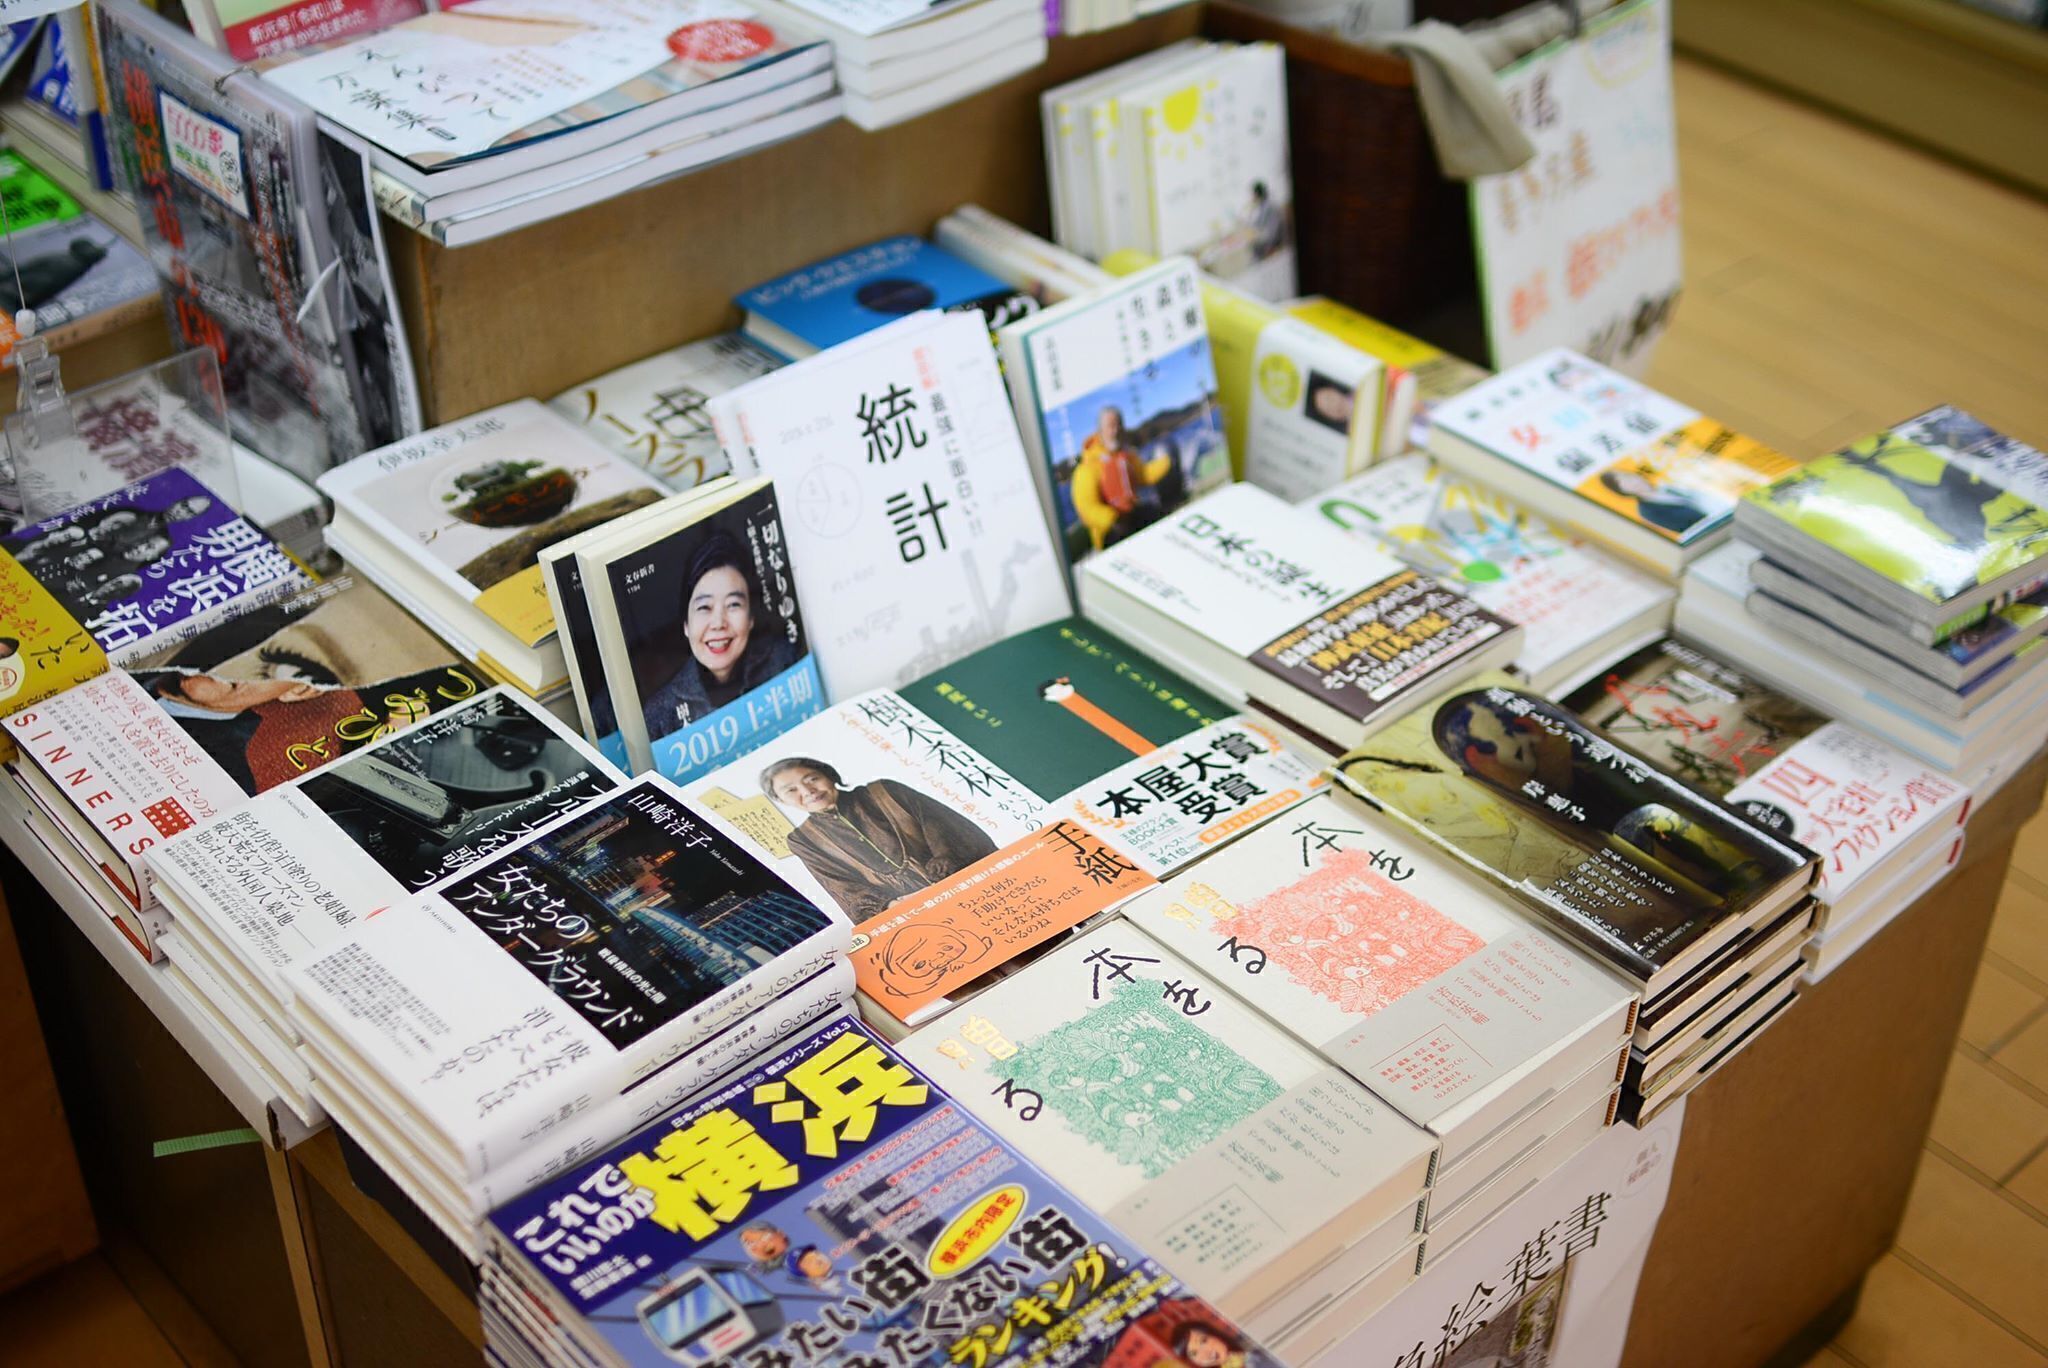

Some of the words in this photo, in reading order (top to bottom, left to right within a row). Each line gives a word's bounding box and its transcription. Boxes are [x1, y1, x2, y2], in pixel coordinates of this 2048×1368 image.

[856, 384, 948, 563] 統計
[624, 563, 656, 585] 文春新書
[756, 503, 798, 644] 一切なりゆき
[668, 715, 739, 778] 2019
[746, 667, 813, 731] 上半期
[857, 694, 1011, 797] 樹木希林
[14, 712, 155, 856] SINNERS
[1097, 732, 1268, 818] 本屋大賞
[1174, 773, 1268, 825] 受賞
[628, 793, 713, 849] 山崎洋子
[1046, 821, 1140, 888] 手紙
[1127, 817, 1179, 846] BOOK大賞
[1156, 846, 1191, 867] 第1位
[486, 863, 589, 940] 女たちの
[957, 876, 1018, 910] ちょっと何か
[970, 875, 1048, 919] 手助けできたら
[980, 897, 1043, 929] いいなって、
[992, 885, 1083, 935] そんな気持ちでは
[453, 882, 644, 1029] アンダーグラウンド
[1005, 918, 1052, 945] いるのね
[598, 946, 668, 1005] 戦後横浜の光と闇
[822, 1020, 852, 1043] Vol.3
[617, 1031, 930, 1242] 横浜
[514, 1163, 633, 1253] これで
[541, 1187, 656, 1275] いいのか
[939, 1192, 1016, 1266] 横浜市内限定
